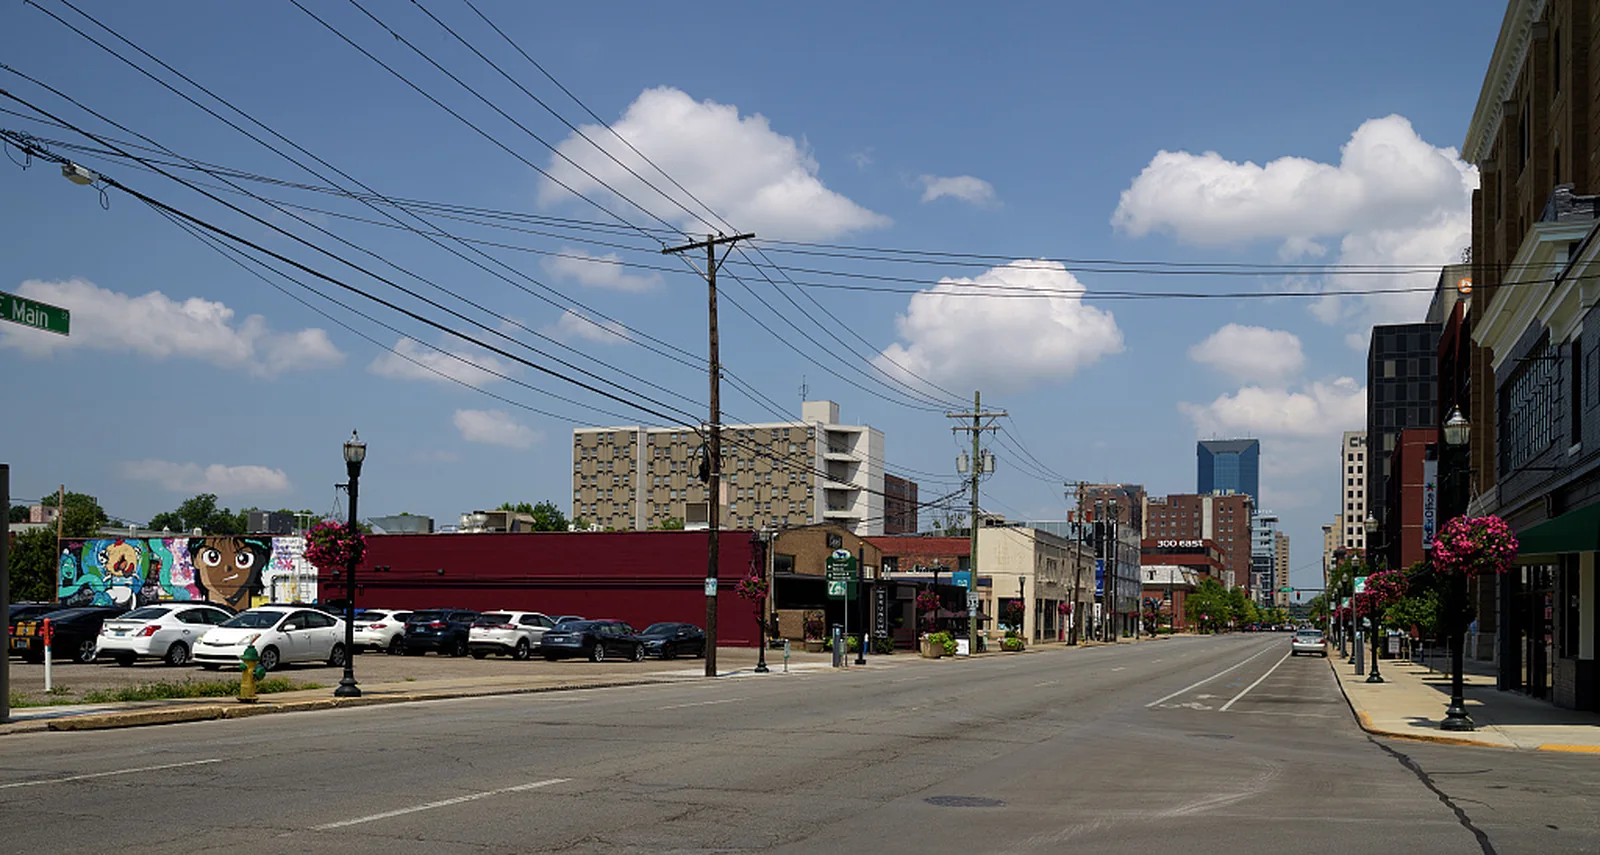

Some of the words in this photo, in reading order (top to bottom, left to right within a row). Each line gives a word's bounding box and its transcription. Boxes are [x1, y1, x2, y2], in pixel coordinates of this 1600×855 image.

[12, 300, 48, 328] Main
[1157, 540, 1177, 548] 300
[1179, 540, 1203, 548] east
